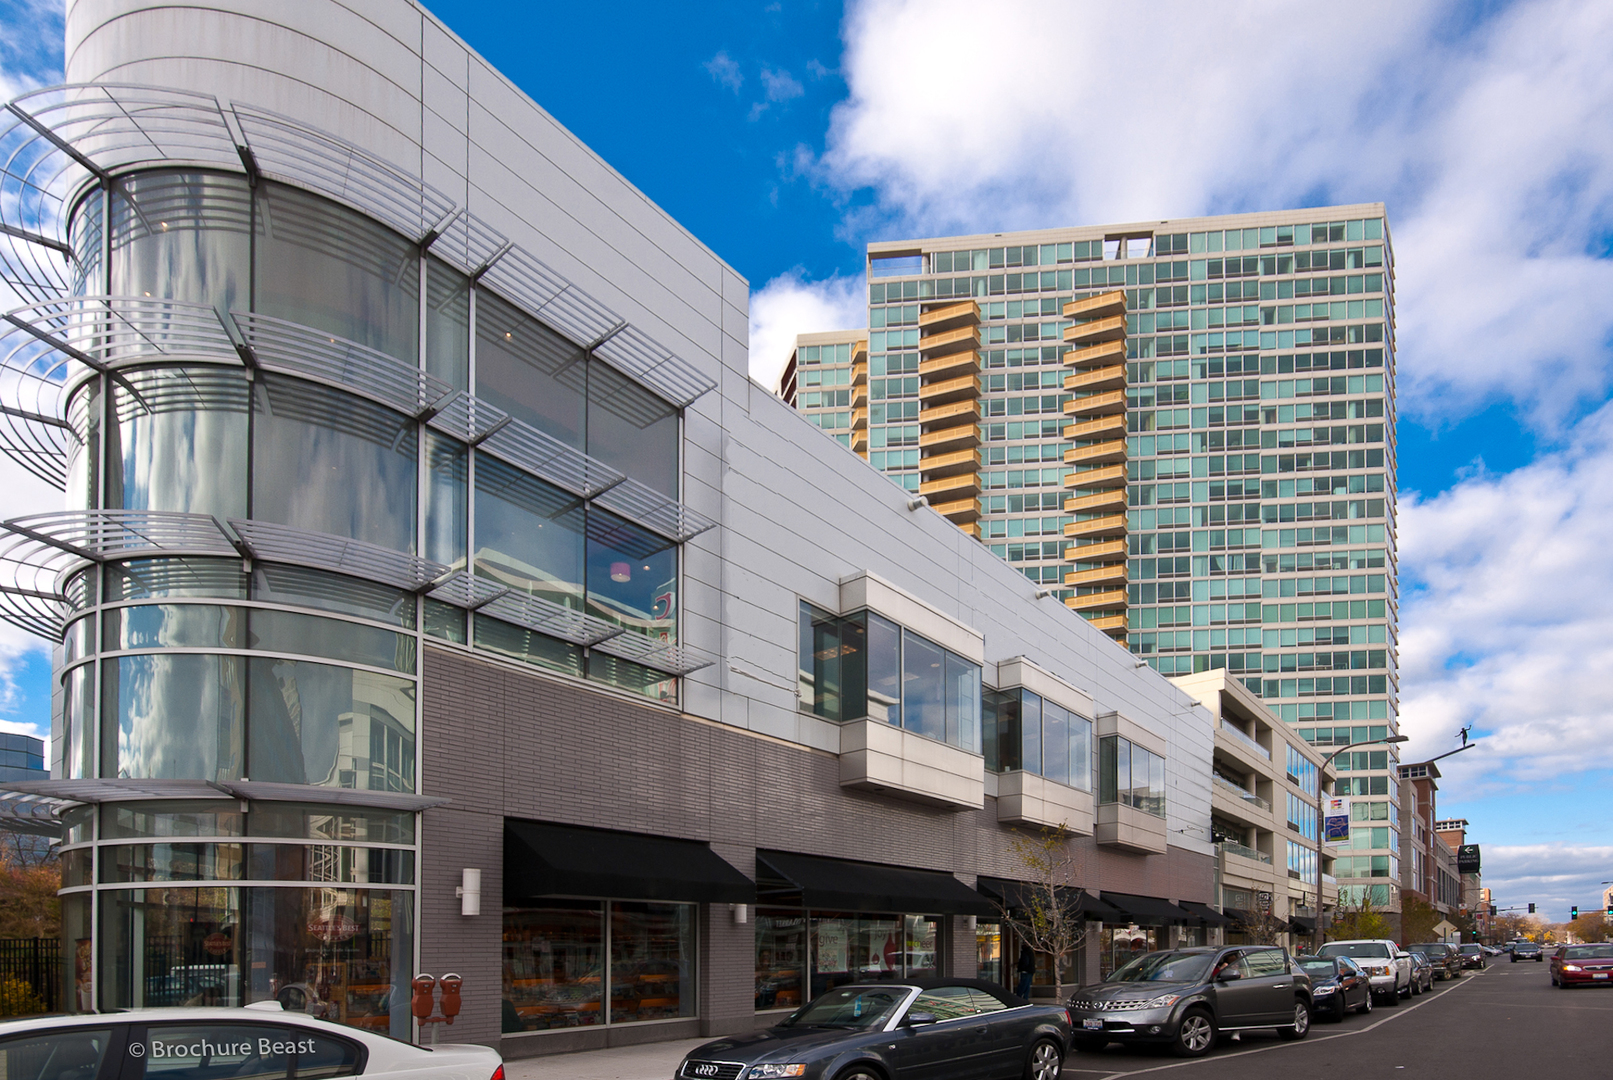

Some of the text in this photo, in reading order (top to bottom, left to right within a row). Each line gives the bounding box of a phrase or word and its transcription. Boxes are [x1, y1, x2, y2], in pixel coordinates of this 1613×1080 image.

[343, 924, 360, 932] BEST
[819, 932, 838, 947] give
[914, 937, 933, 948] cheer
